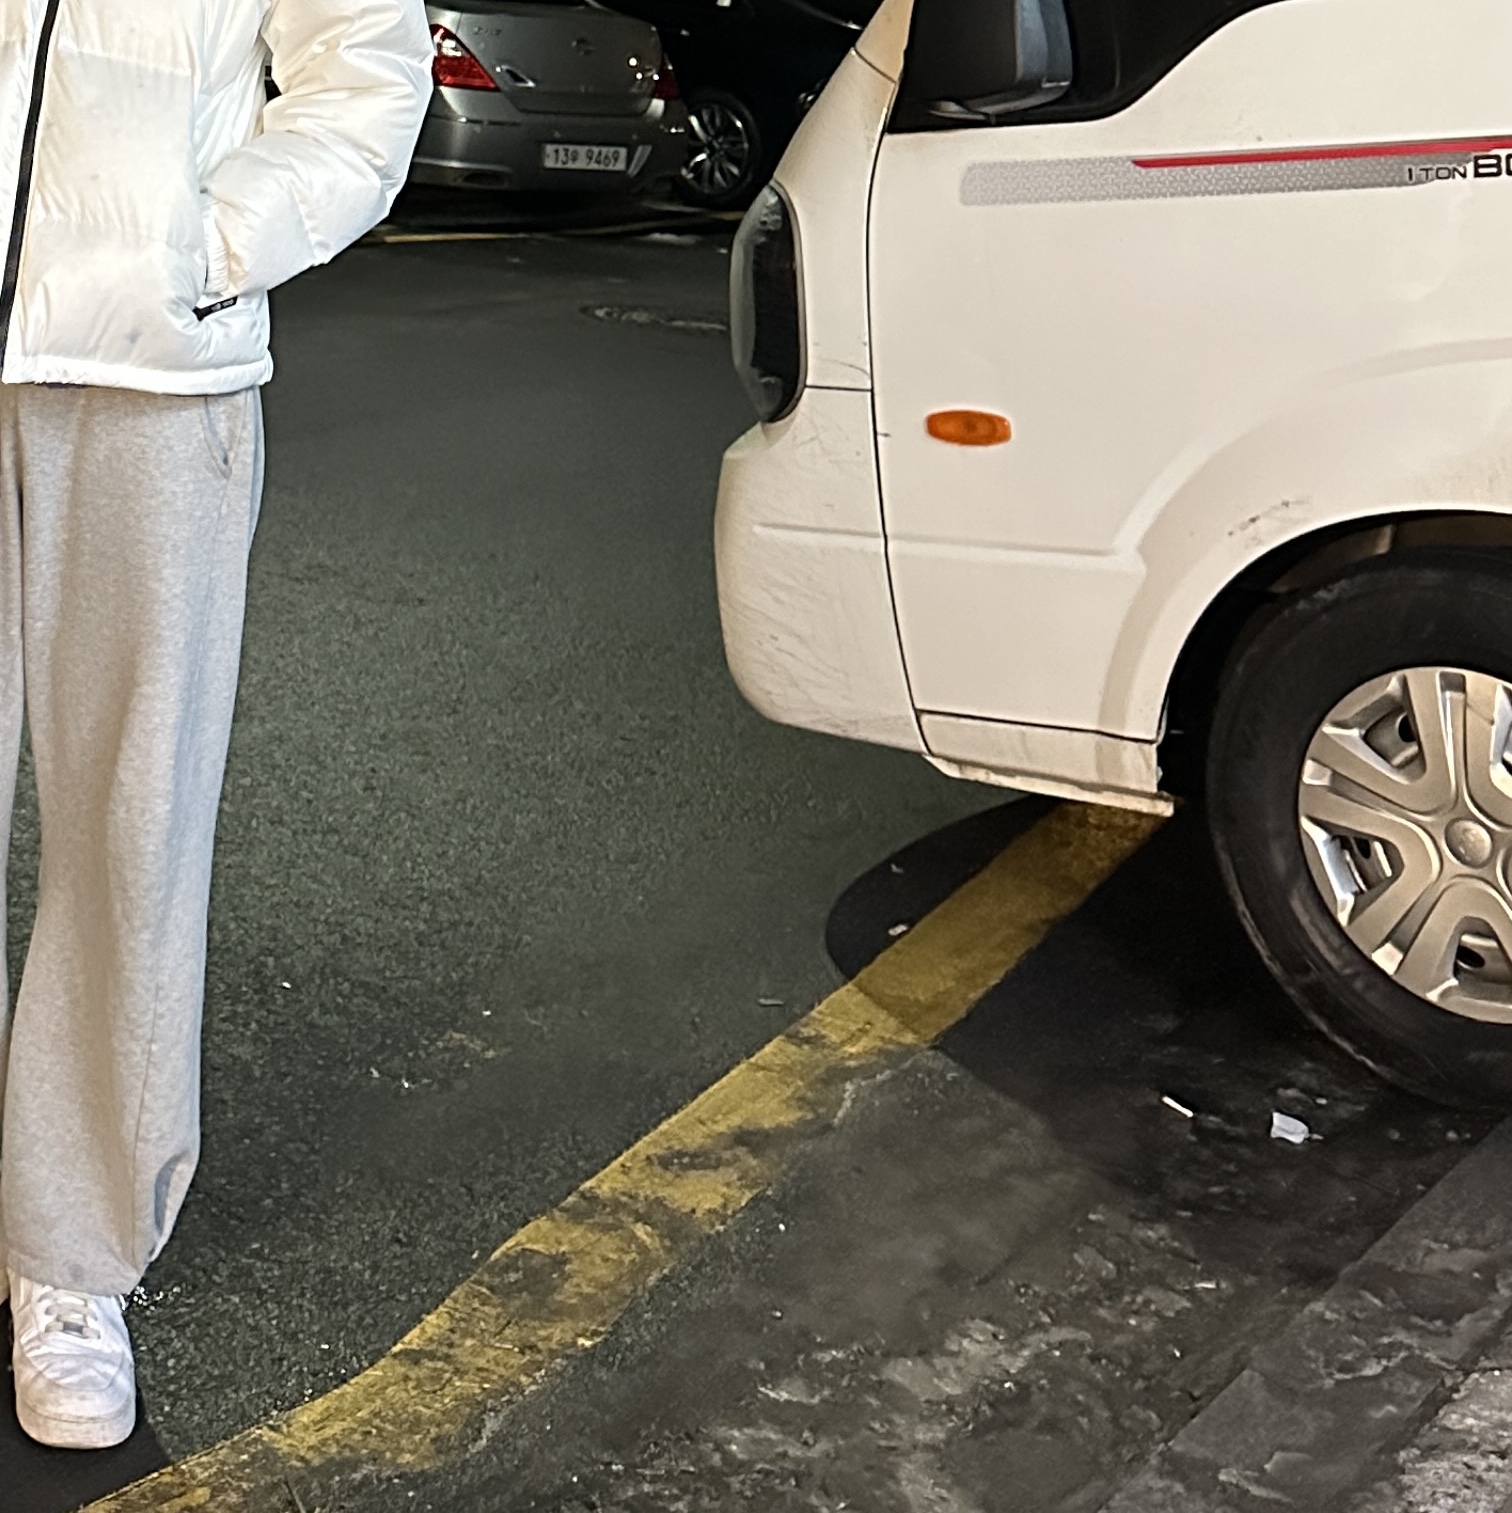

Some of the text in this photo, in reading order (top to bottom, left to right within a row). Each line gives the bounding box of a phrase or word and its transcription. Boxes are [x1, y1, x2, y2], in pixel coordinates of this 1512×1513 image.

[585, 149, 620, 168] 9469
[1419, 165, 1467, 180] TON
[1473, 153, 1512, 178] B
